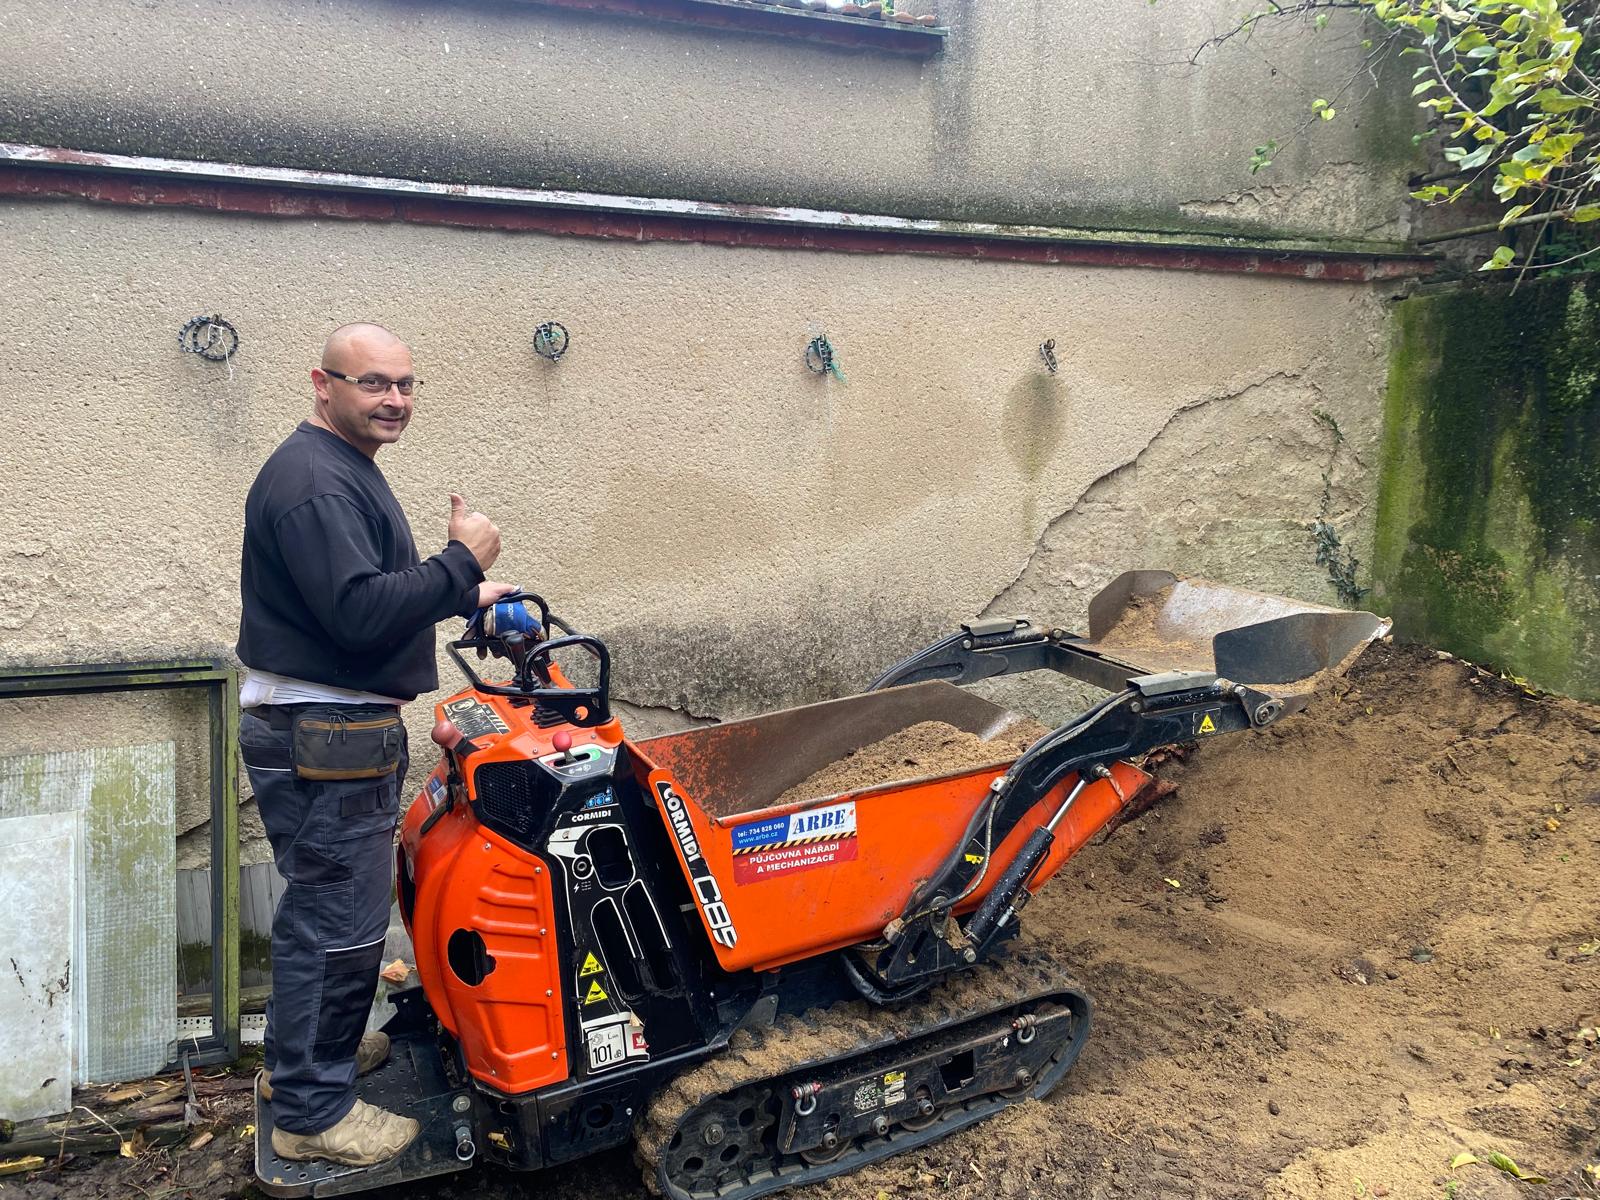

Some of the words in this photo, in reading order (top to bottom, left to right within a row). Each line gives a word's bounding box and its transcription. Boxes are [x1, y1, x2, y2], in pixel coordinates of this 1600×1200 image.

[571, 809, 612, 822] CORMIDI
[664, 787, 701, 862] CORMIDI
[793, 809, 845, 834] ARBE
[738, 830, 747, 838] tel:
[750, 827, 760, 835] 734
[738, 831, 778, 844] www.arbe.cz
[767, 853, 835, 872] MECHANIZACE
[593, 1044, 612, 1064] 101
